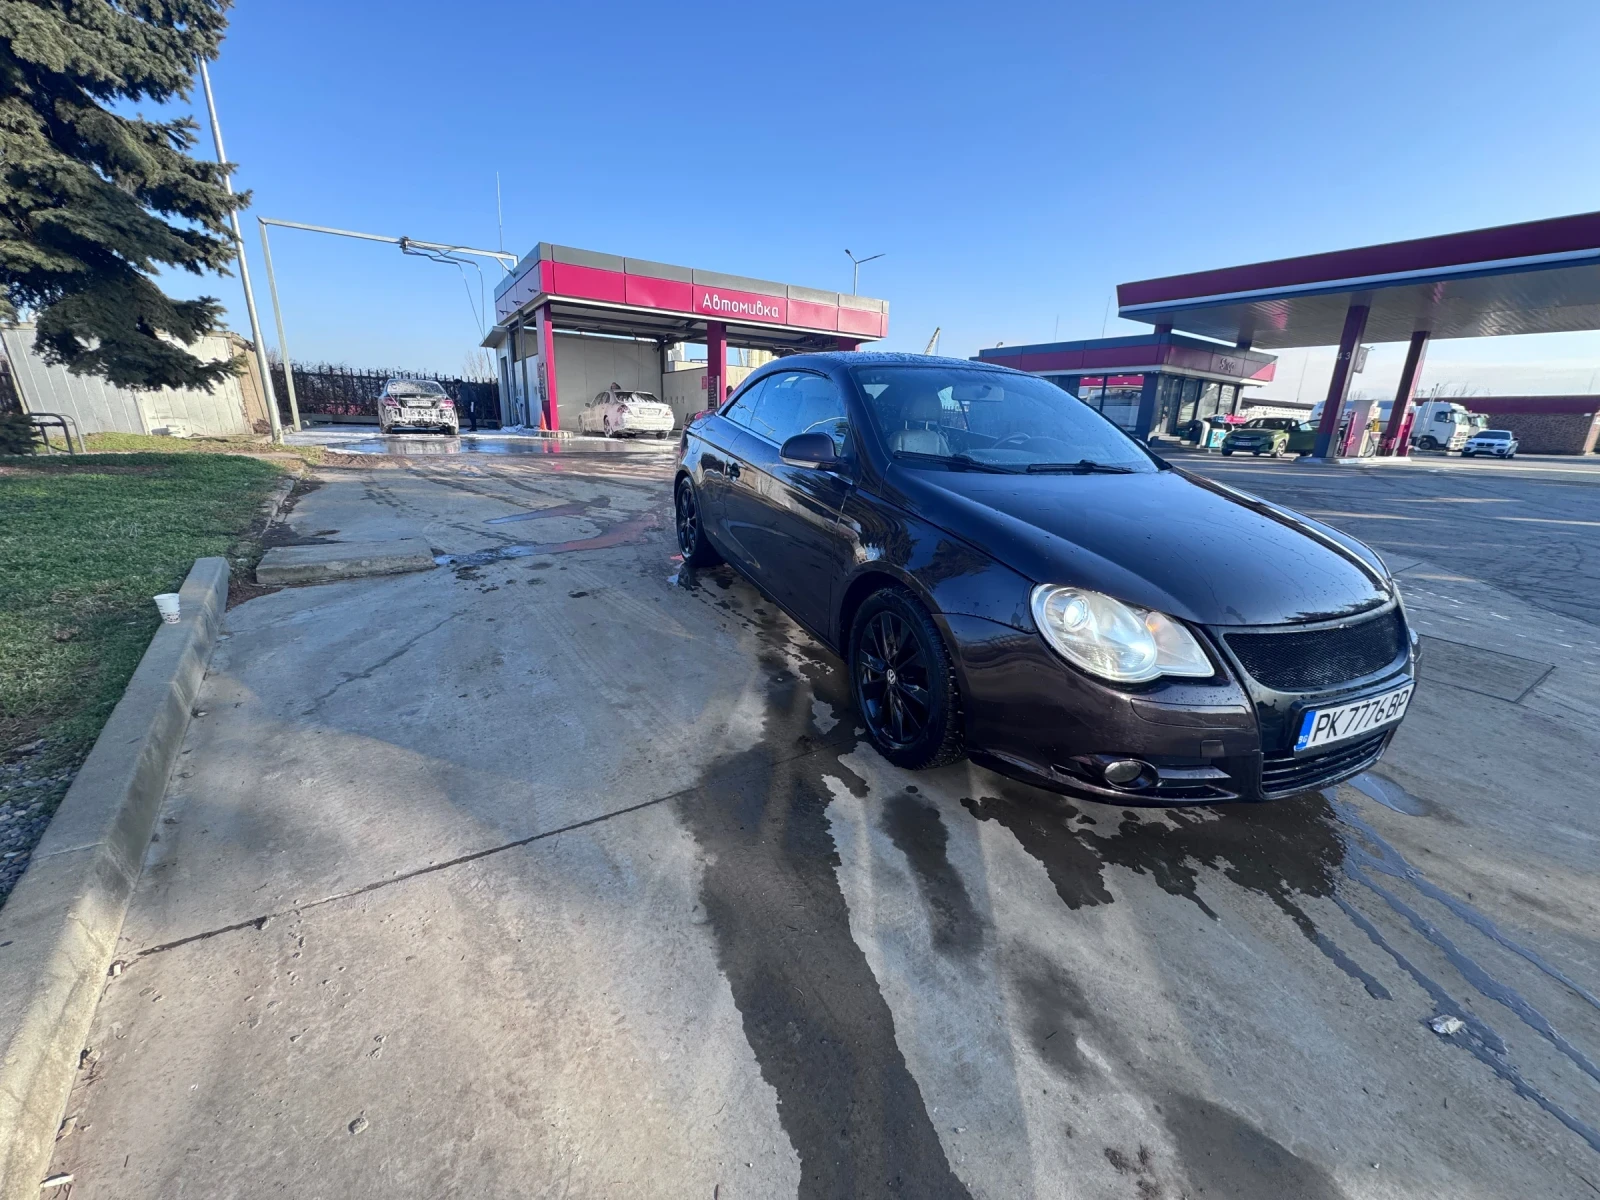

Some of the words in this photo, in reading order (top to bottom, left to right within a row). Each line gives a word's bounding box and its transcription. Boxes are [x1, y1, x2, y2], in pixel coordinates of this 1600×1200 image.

[702, 292, 779, 318] Автомивка
[1311, 709, 1345, 743] PK
[1342, 697, 1388, 735] 7776
[1385, 689, 1410, 720] BP
